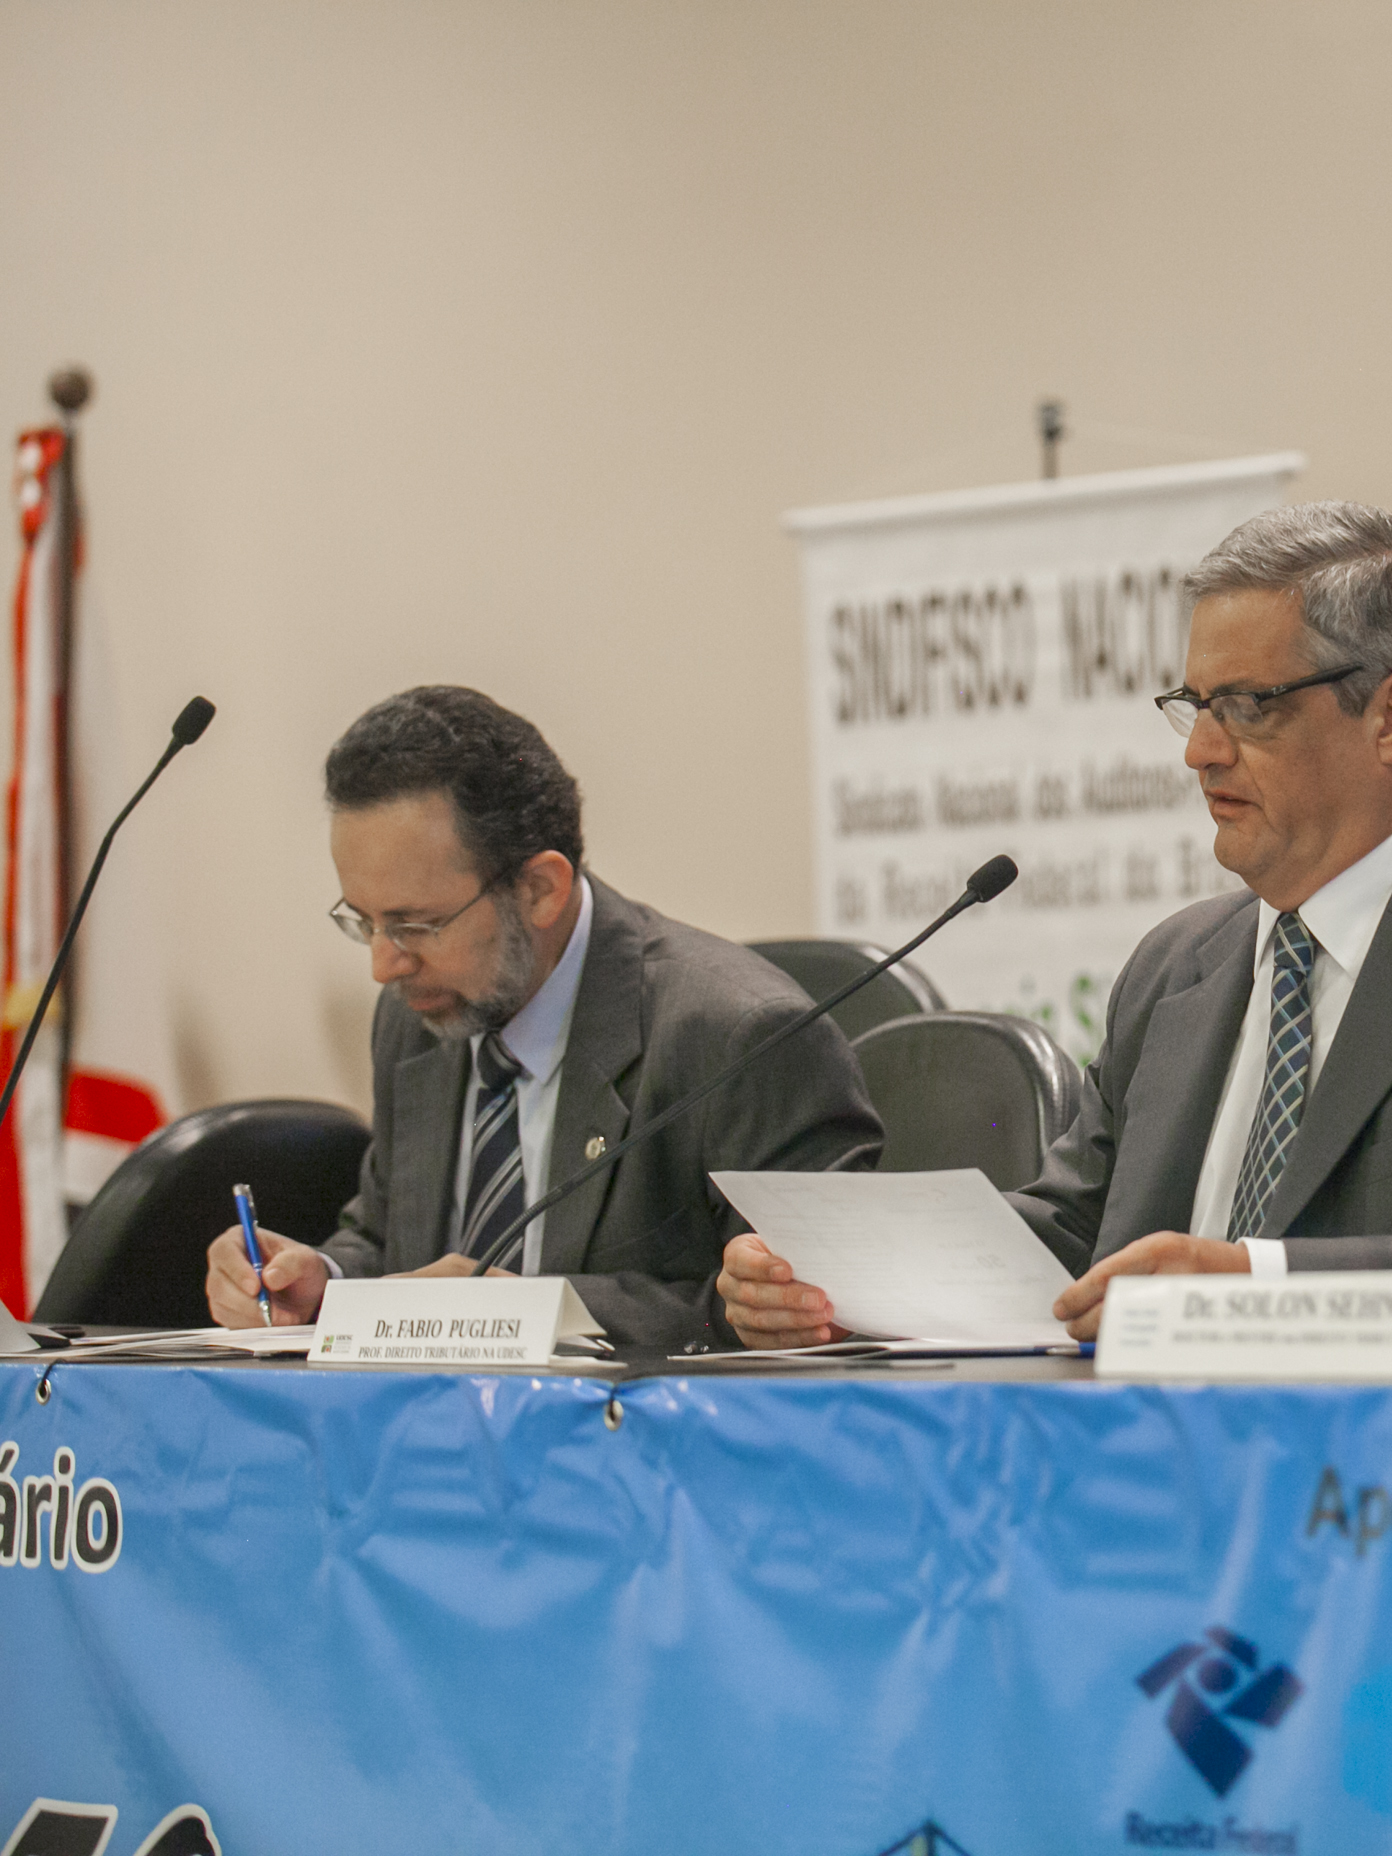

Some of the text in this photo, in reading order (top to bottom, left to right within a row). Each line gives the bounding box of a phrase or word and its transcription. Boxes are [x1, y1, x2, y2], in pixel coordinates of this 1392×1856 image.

[374, 1319, 522, 1339] Dr. FABIO PUGLIESI
[384, 1346, 422, 1359] DIREITO
[424, 1344, 481, 1360] TRIBUTÁRIO
[482, 1347, 495, 1359] NA
[496, 1347, 527, 1360] UDESC
